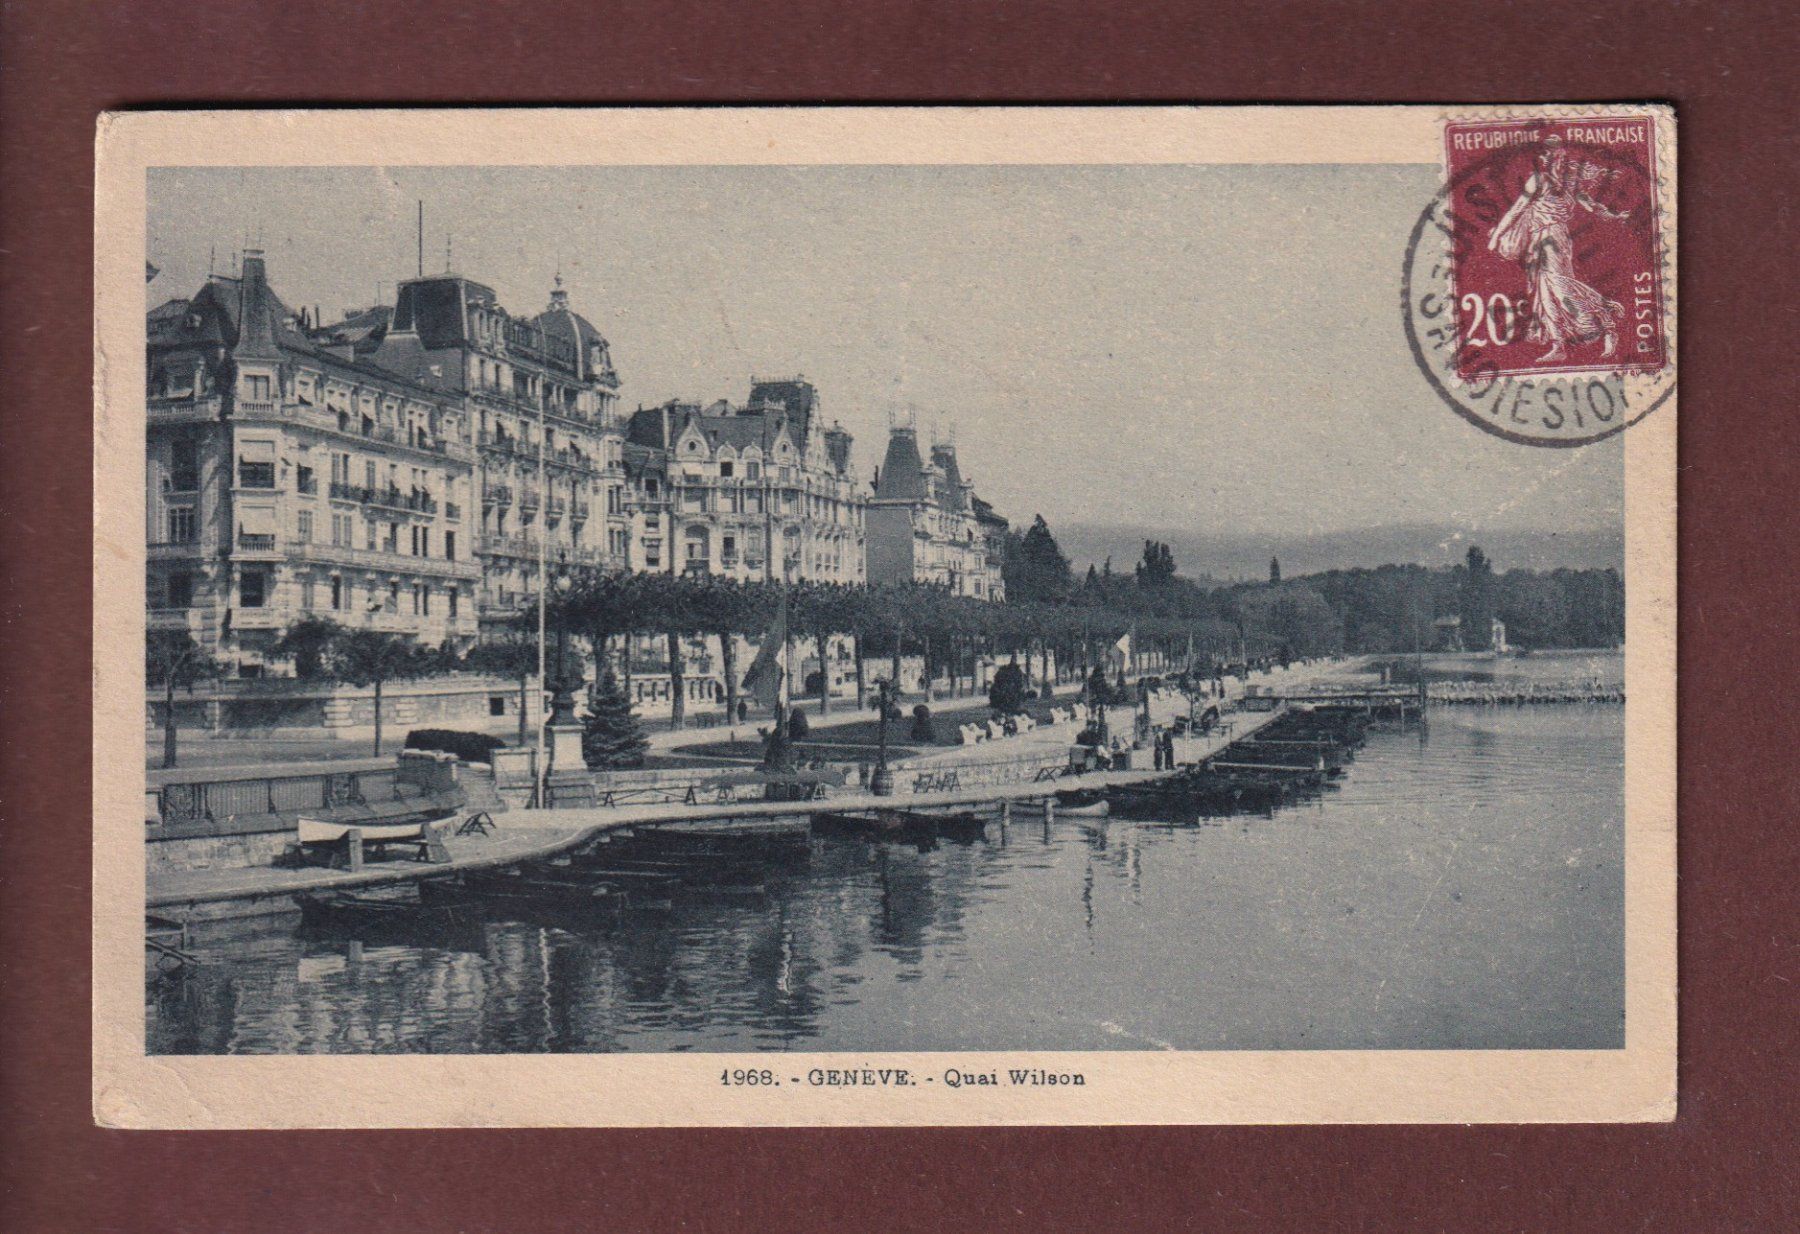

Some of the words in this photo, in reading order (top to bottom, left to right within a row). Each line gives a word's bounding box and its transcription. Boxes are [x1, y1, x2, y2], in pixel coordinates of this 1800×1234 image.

[1566, 125, 1645, 144] FRANÇAISE
[1633, 271, 1654, 353] POSTES
[720, 1068, 781, 1087] 1968.
[944, 1068, 998, 1089] Quai
[1008, 1068, 1086, 1087] Wilson
